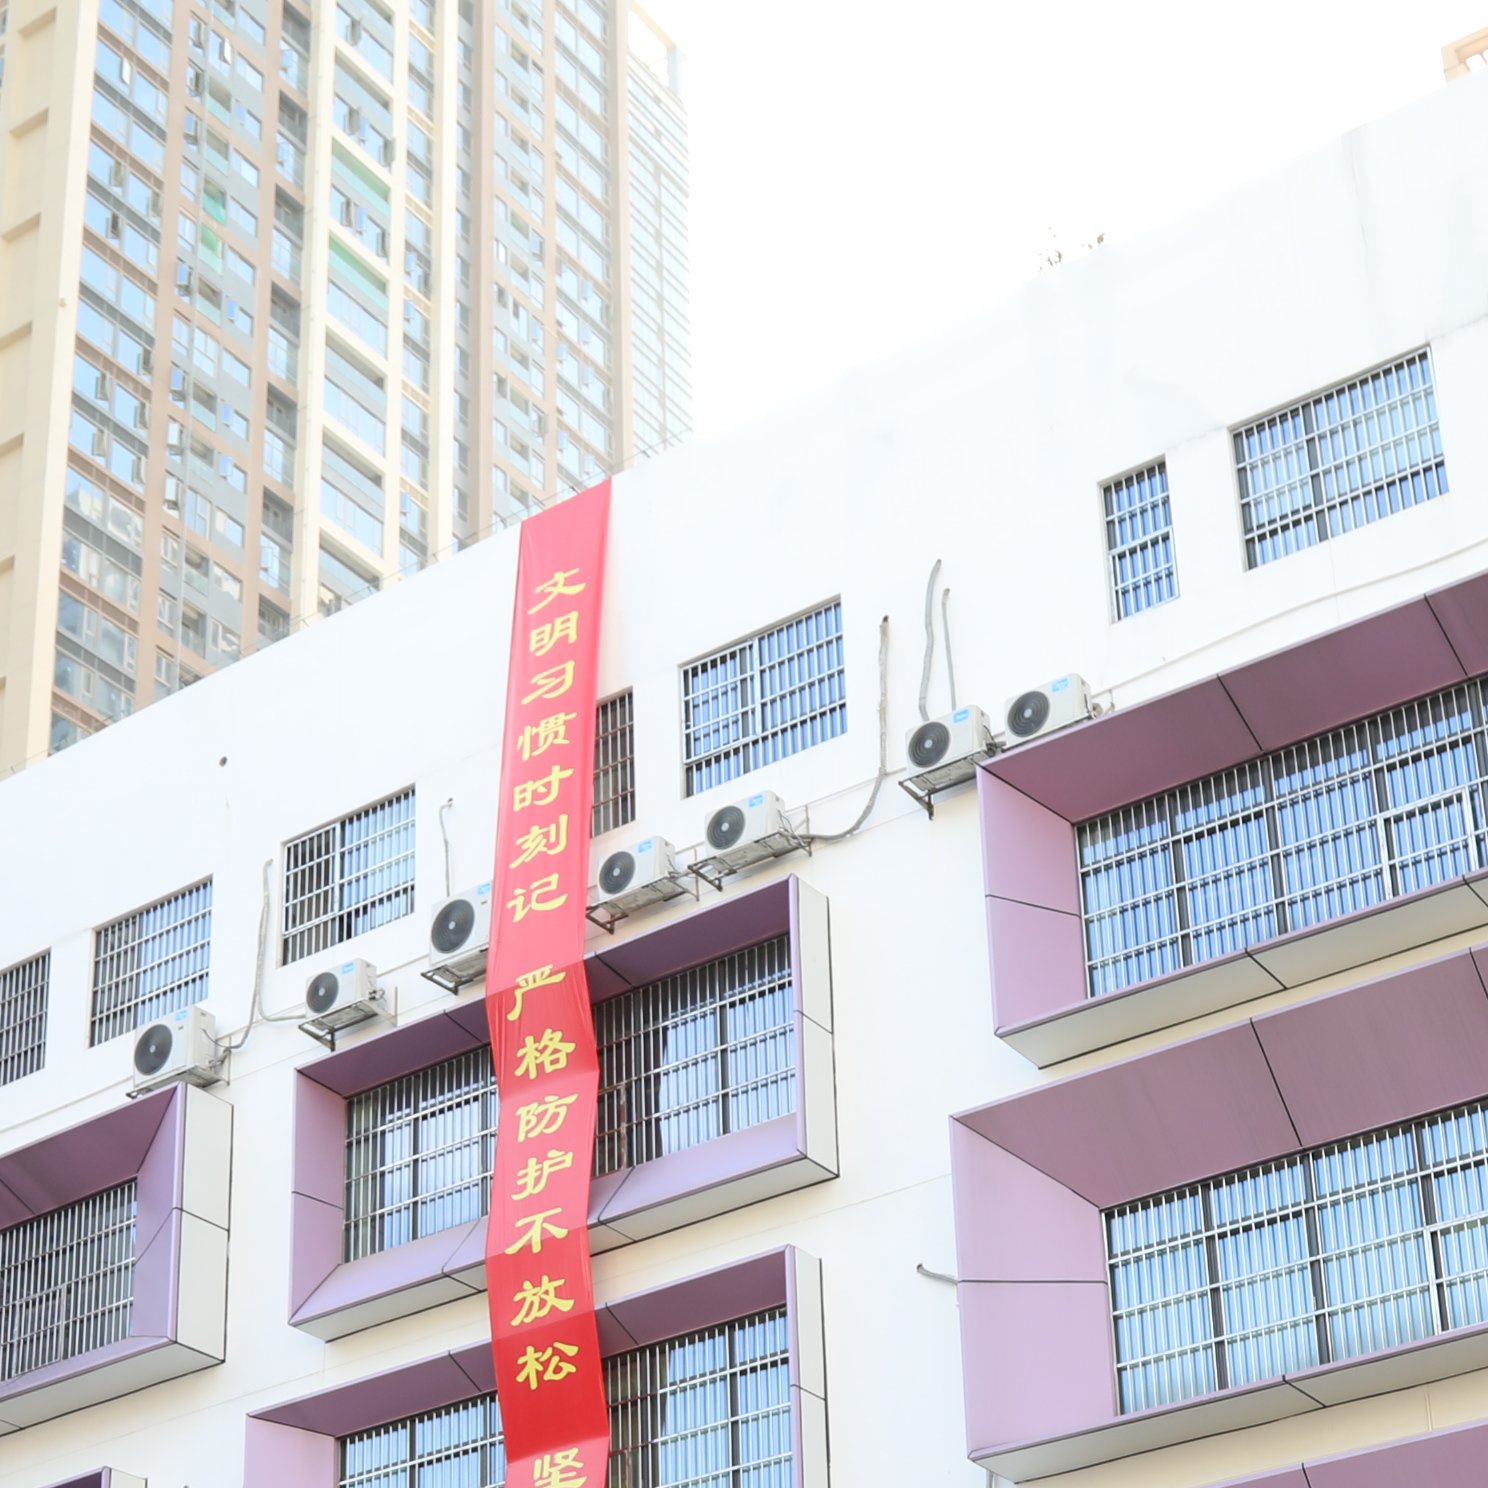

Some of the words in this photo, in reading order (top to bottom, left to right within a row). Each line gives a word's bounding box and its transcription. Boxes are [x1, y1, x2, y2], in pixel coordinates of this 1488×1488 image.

[512, 568, 586, 922] 文明习惯时刻记
[504, 964, 578, 1390] 严格防护不放松
